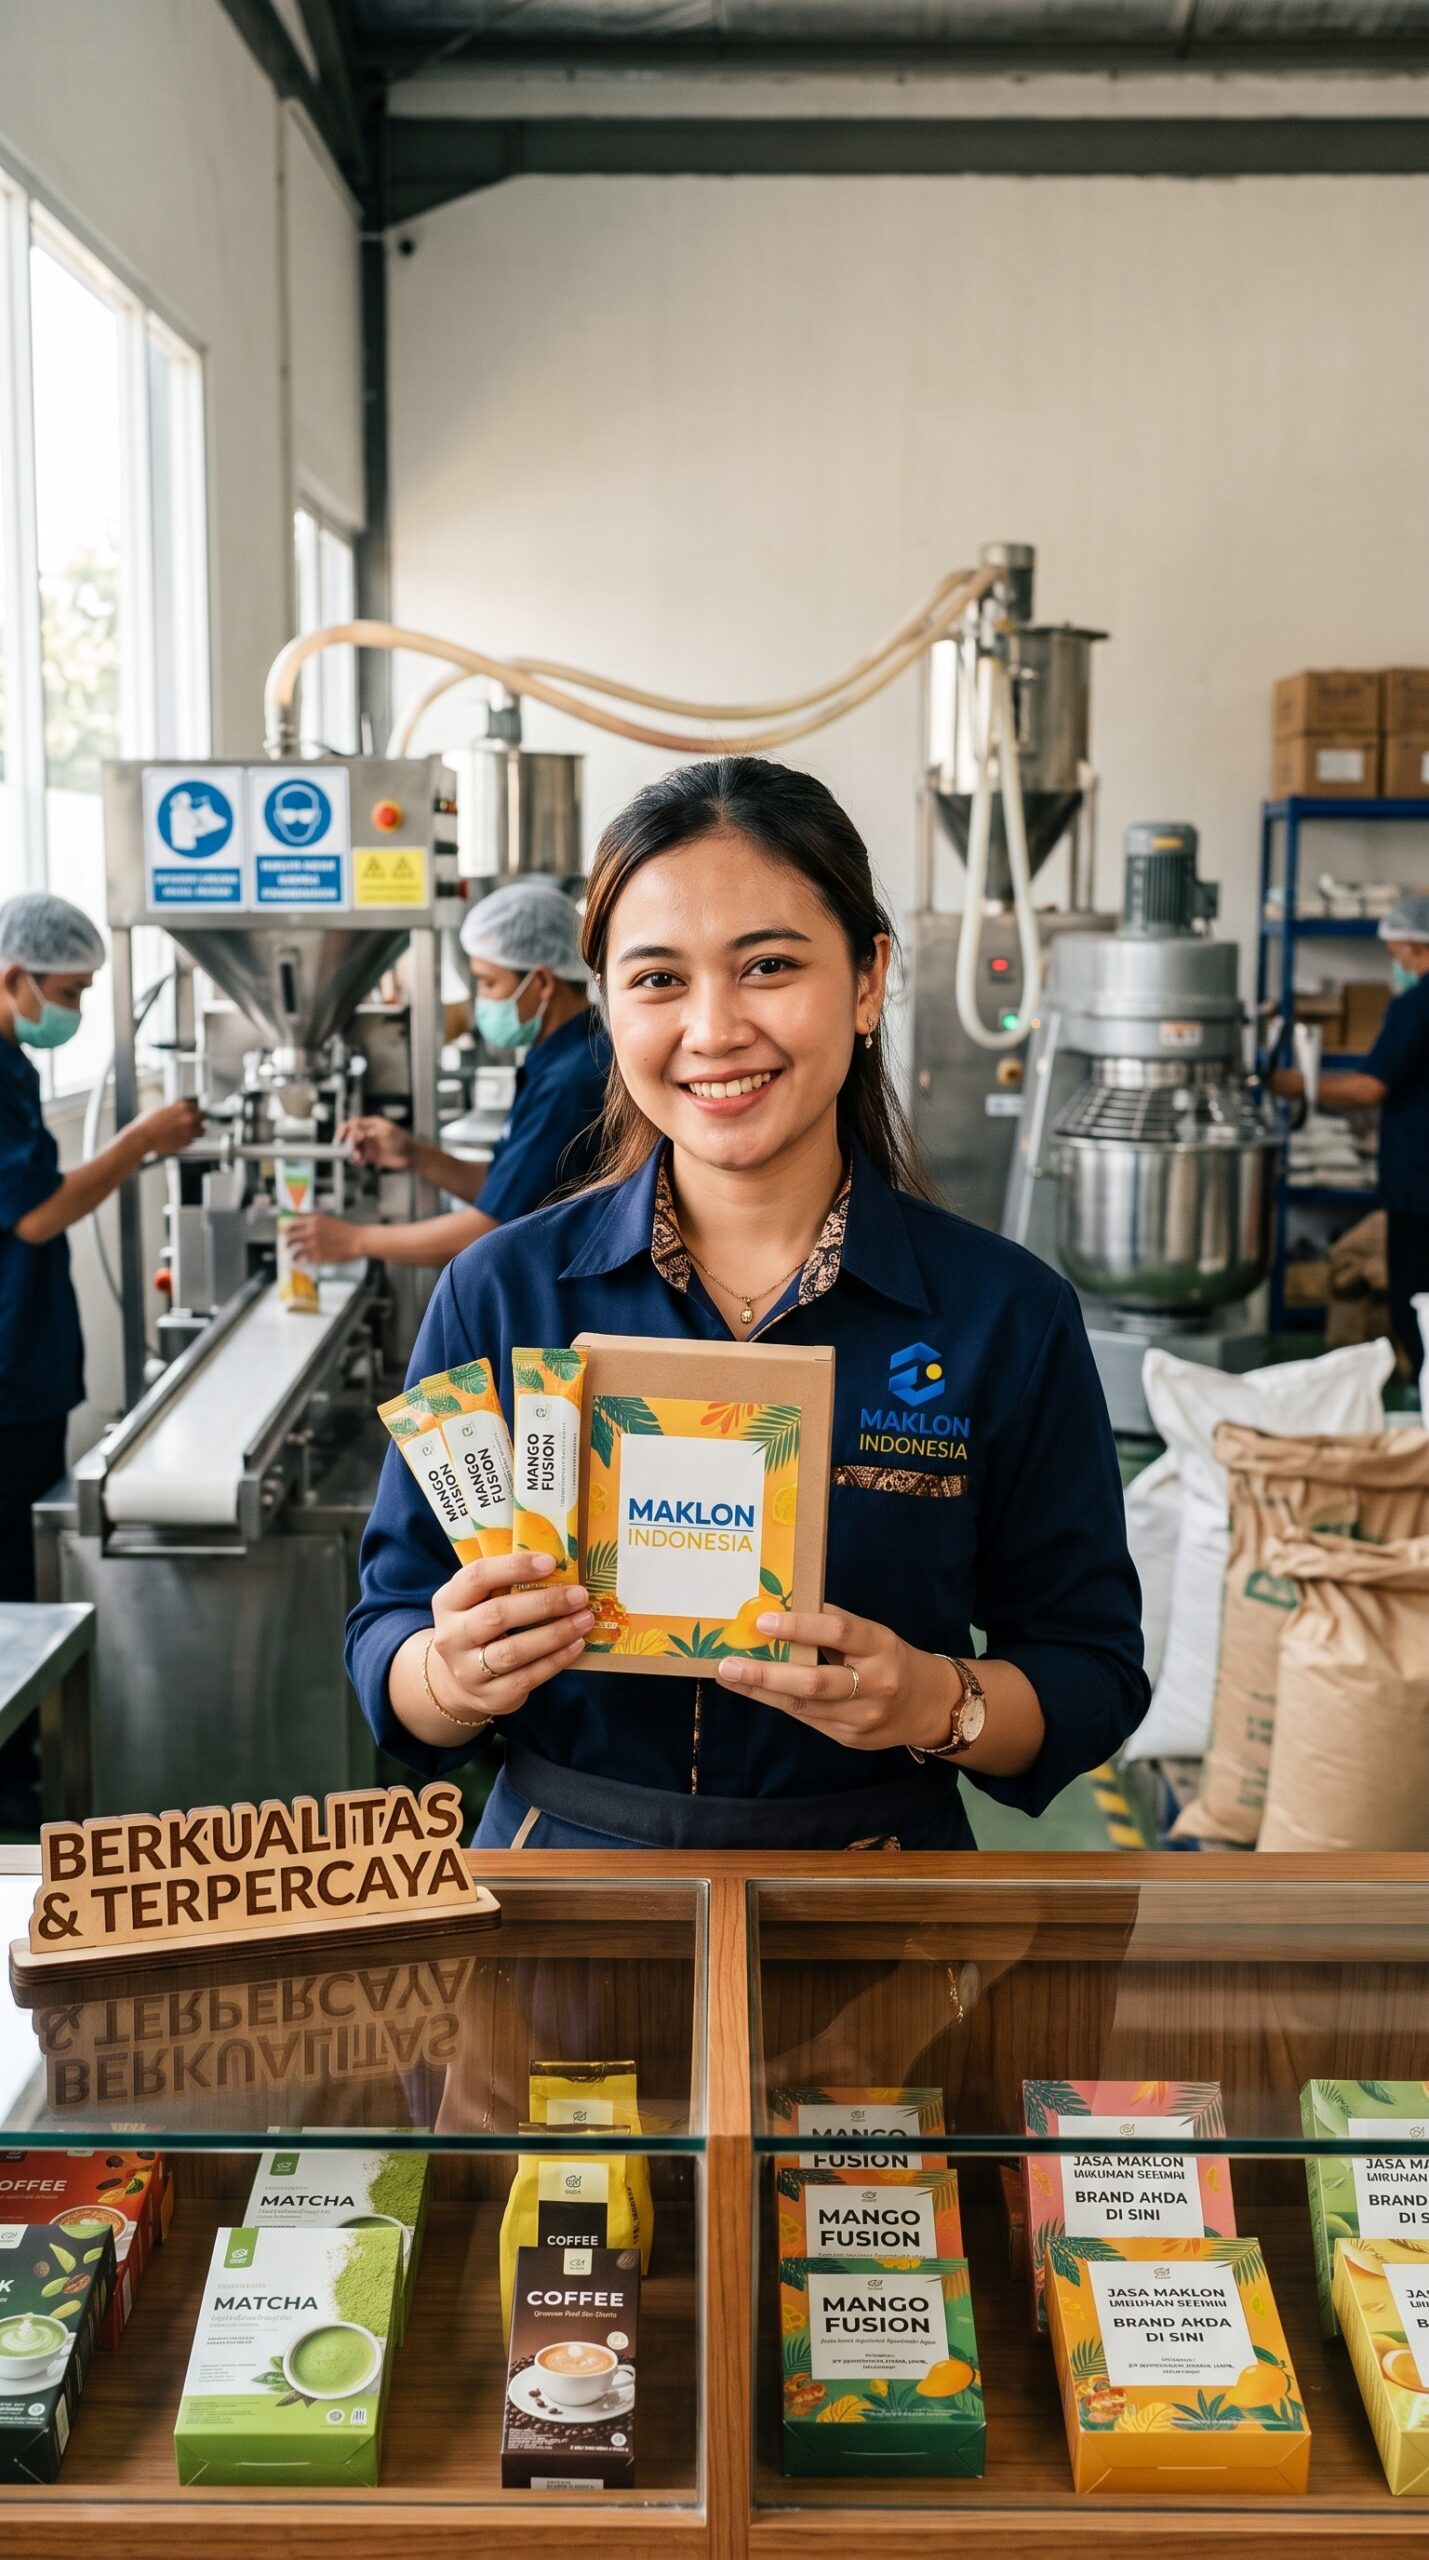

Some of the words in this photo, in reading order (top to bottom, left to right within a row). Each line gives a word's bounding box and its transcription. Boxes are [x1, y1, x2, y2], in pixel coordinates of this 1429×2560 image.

[860, 1407, 971, 1439] MAKLON
[859, 1433, 968, 1460] INDONESIA
[526, 1433, 540, 1491] MANGO
[541, 1433, 555, 1491] FUSION
[464, 1453, 492, 1508] MANGO
[477, 1448, 506, 1504] FUSION
[428, 1470, 459, 1523] MANGO
[628, 1497, 755, 1528] MAKLON
[627, 1528, 754, 1553] INDONESIA
[47, 1791, 458, 1882] BERKUALITAS
[37, 1892, 84, 1941] &
[90, 1847, 470, 1933] TERPERCAYA
[1073, 2156, 1113, 2167] JASA
[1117, 2156, 1184, 2168] MAKLON
[1366, 2158, 1406, 2169] JASA
[260, 2195, 356, 2207] MATCHA
[1075, 2190, 1135, 2204] BRAND
[1369, 2194, 1427, 2206] BRAND
[818, 2209, 921, 2225] MANGO
[1105, 2208, 1123, 2220] DI
[1128, 2208, 1161, 2221] SINI
[1399, 2212, 1416, 2224] DI
[547, 2235, 599, 2246] COFFEE
[820, 2230, 921, 2247] FUSION
[526, 2290, 625, 2307] COFFEE
[1107, 2288, 1149, 2297] JASA
[1153, 2288, 1225, 2298] MAKLON
[213, 2296, 319, 2311] MATCHA
[822, 2296, 930, 2312] MANGO
[825, 2316, 931, 2334] FUSION
[1113, 2318, 1176, 2328] BRAND
[1146, 2332, 1164, 2342] DI
[1169, 2332, 1204, 2342] SINI
